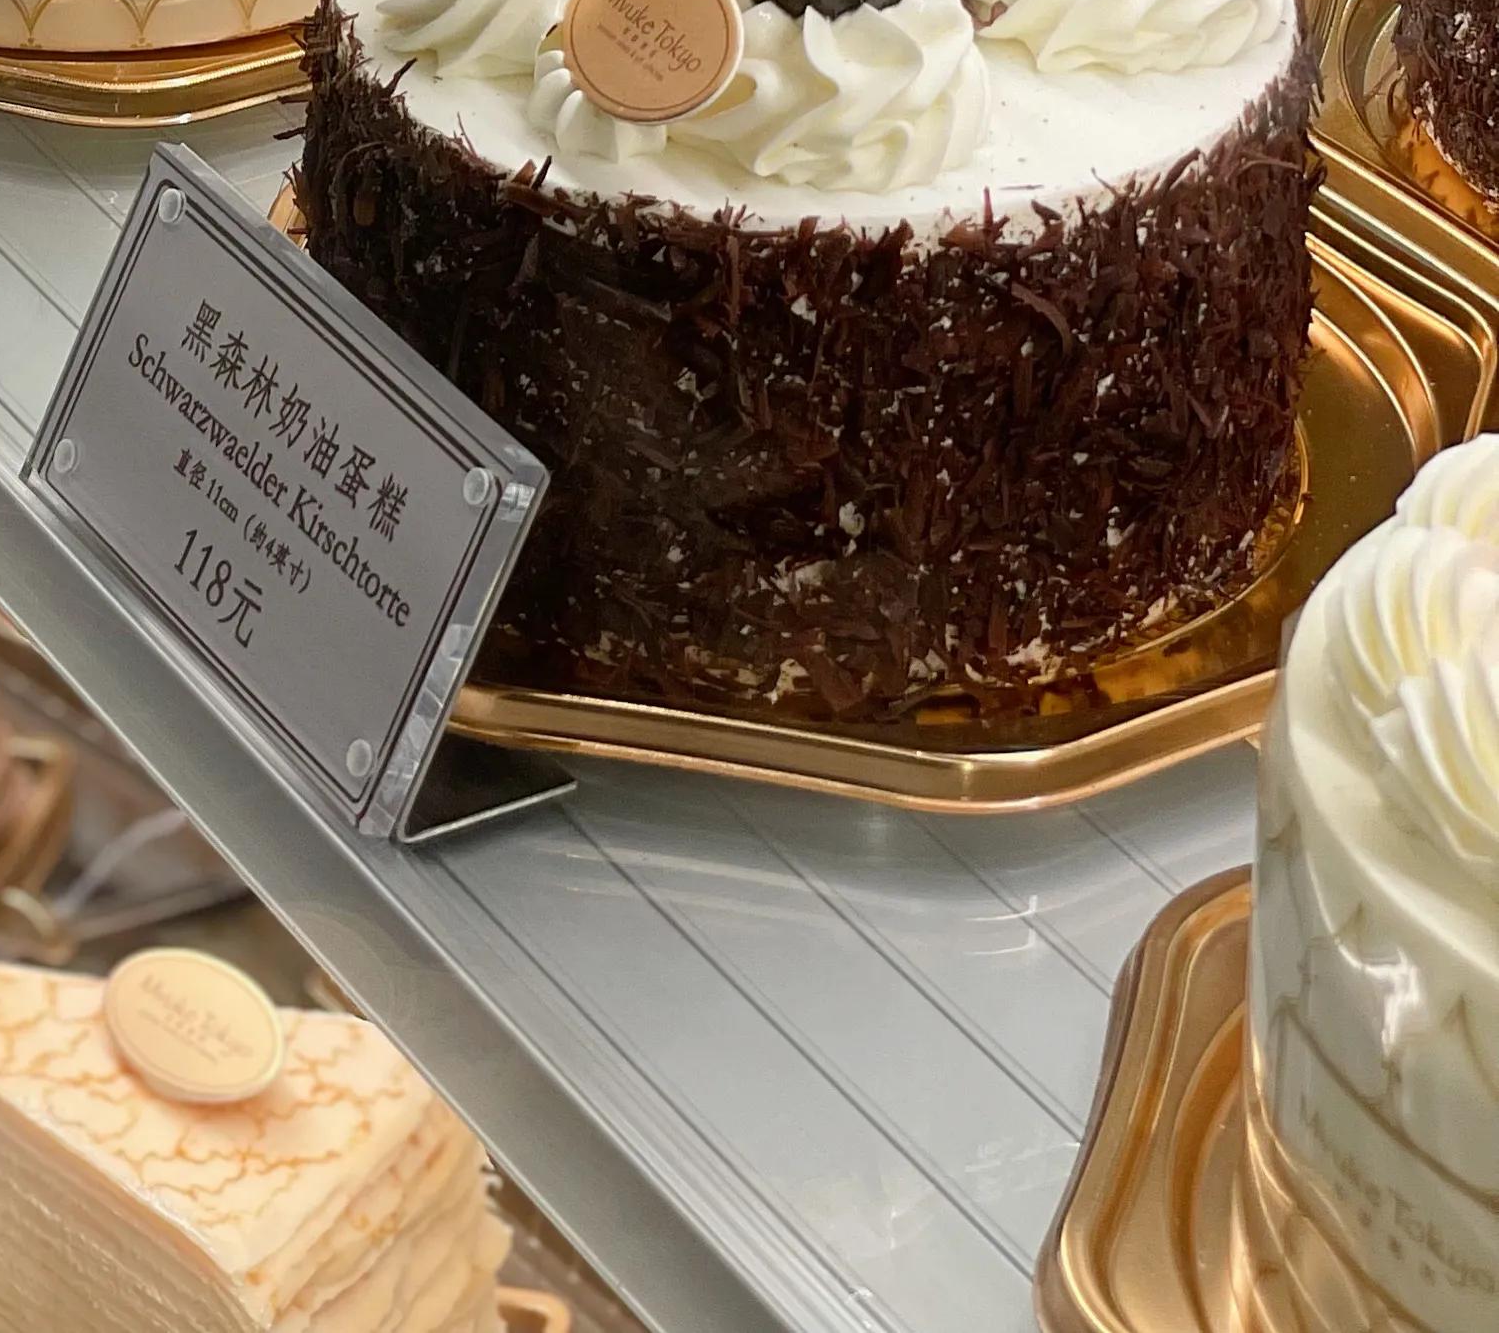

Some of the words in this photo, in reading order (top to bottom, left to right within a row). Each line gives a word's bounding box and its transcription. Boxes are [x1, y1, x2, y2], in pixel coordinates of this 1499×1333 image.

[654, 19, 702, 72] Tokyo
[128, 332, 289, 509] Schwarzwaelder
[288, 485, 412, 628] Kirschtorte
[180, 298, 411, 542] 黑森林奶油蛋糕
[172, 528, 265, 649] 118元
